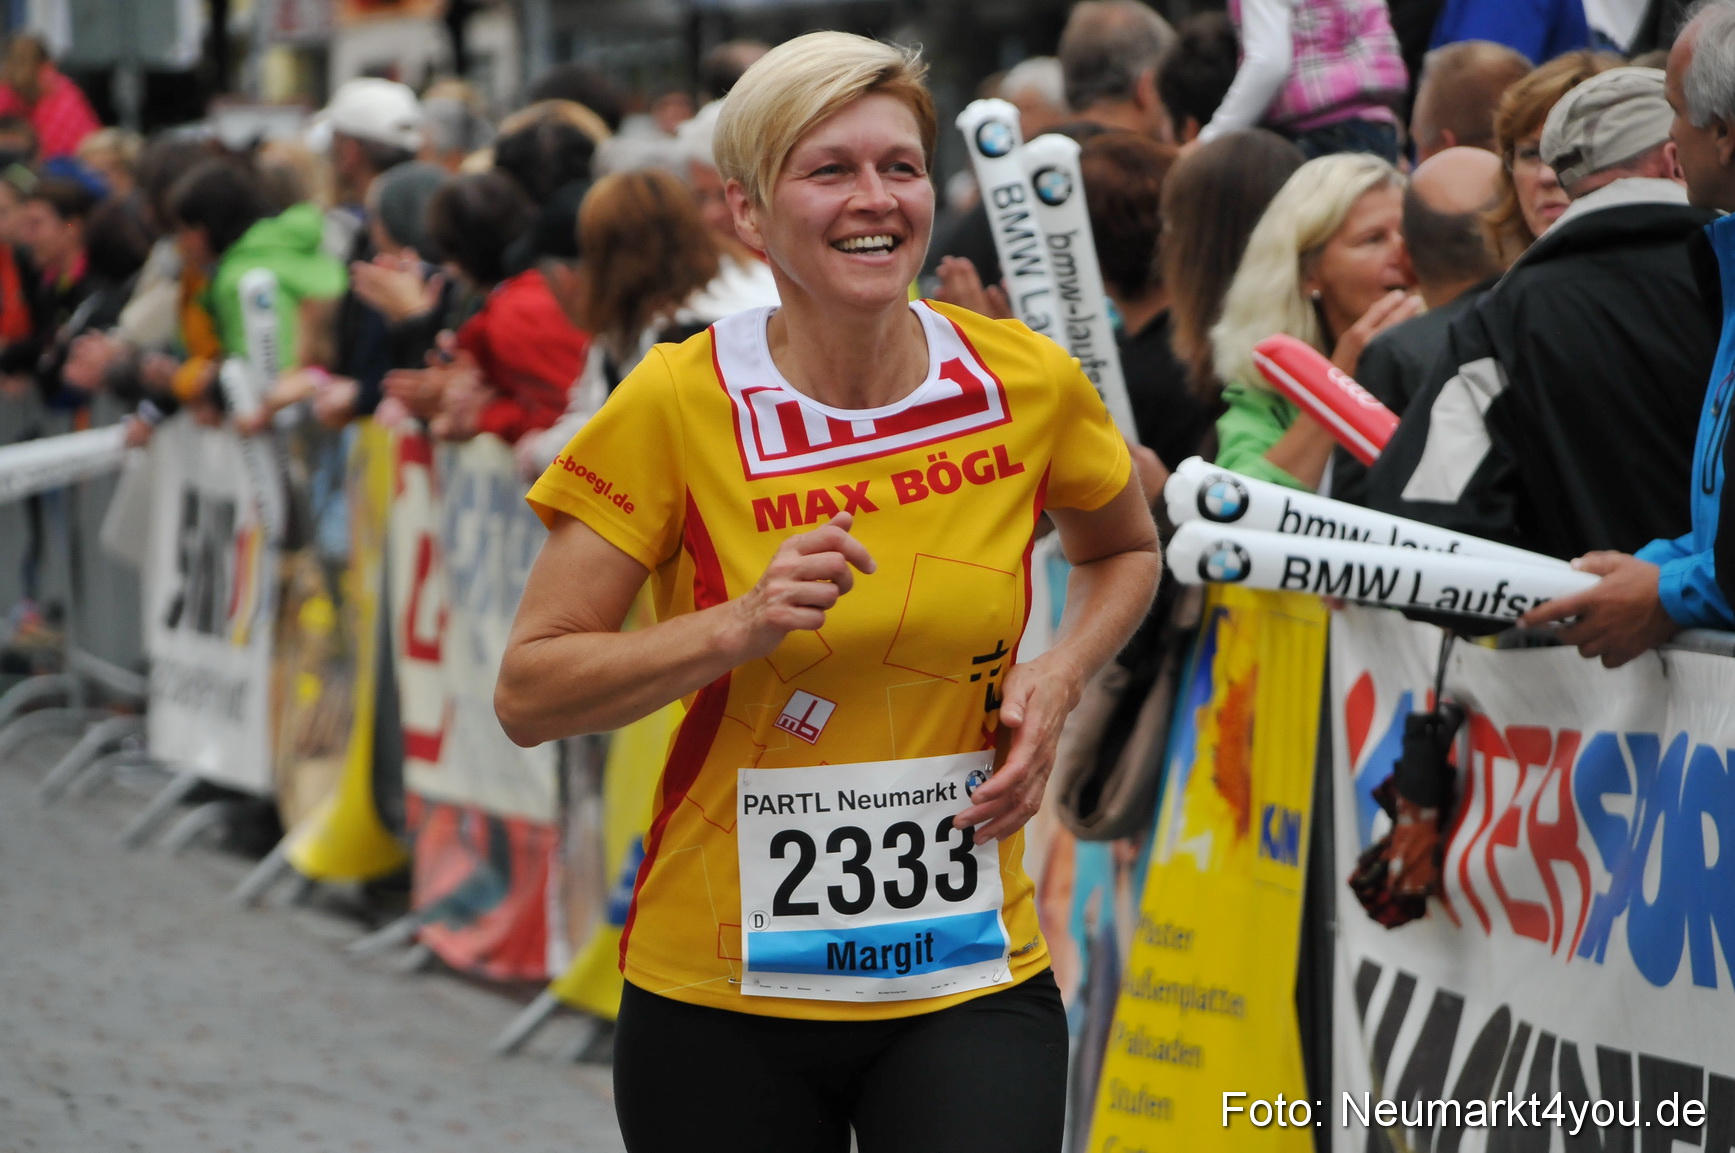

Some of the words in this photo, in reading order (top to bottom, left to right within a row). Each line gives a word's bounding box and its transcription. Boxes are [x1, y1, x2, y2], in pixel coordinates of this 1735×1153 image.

[991, 182, 1045, 277] BMW
[751, 480, 880, 533] MAX
[890, 443, 1026, 506] BÖGL
[1279, 554, 1400, 602] BMW
[743, 792, 832, 815] PARTL
[838, 781, 958, 812] Neumarkt
[769, 814, 979, 917] 2333
[826, 932, 935, 975] Margit
